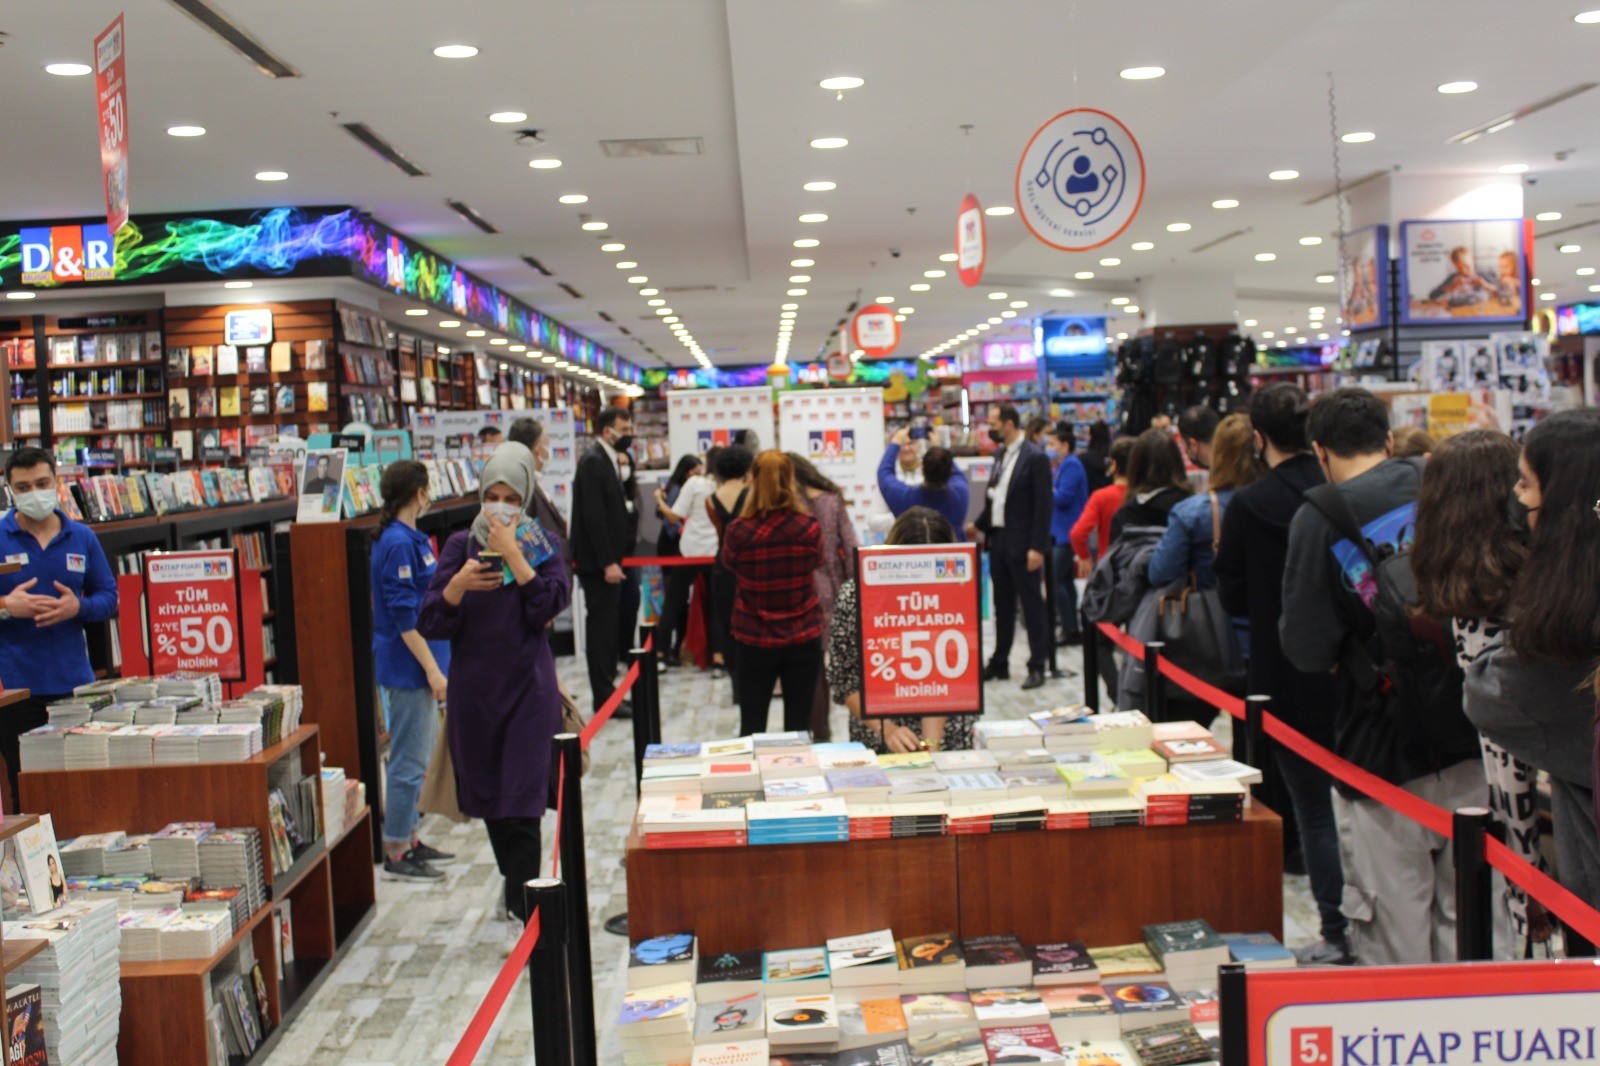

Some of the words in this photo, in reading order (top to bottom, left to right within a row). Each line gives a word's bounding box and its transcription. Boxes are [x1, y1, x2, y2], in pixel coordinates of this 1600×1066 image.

[22, 239, 112, 278] D&R
[810, 441, 854, 458] D&R
[878, 560, 905, 570] KİTAP
[905, 559, 932, 569] FUARI
[175, 587, 208, 602] TÜM
[897, 591, 940, 612] TÜM
[158, 602, 228, 615] KİTAPLARDA
[873, 611, 965, 628] KİTAPLARDA
[177, 655, 218, 669] İNDİRİM
[895, 682, 948, 697] İNDİRİM
[1300, 1033, 1328, 1063] 5.
[1340, 1026, 1462, 1066] KİTAP
[1472, 1026, 1597, 1063] FUARI
